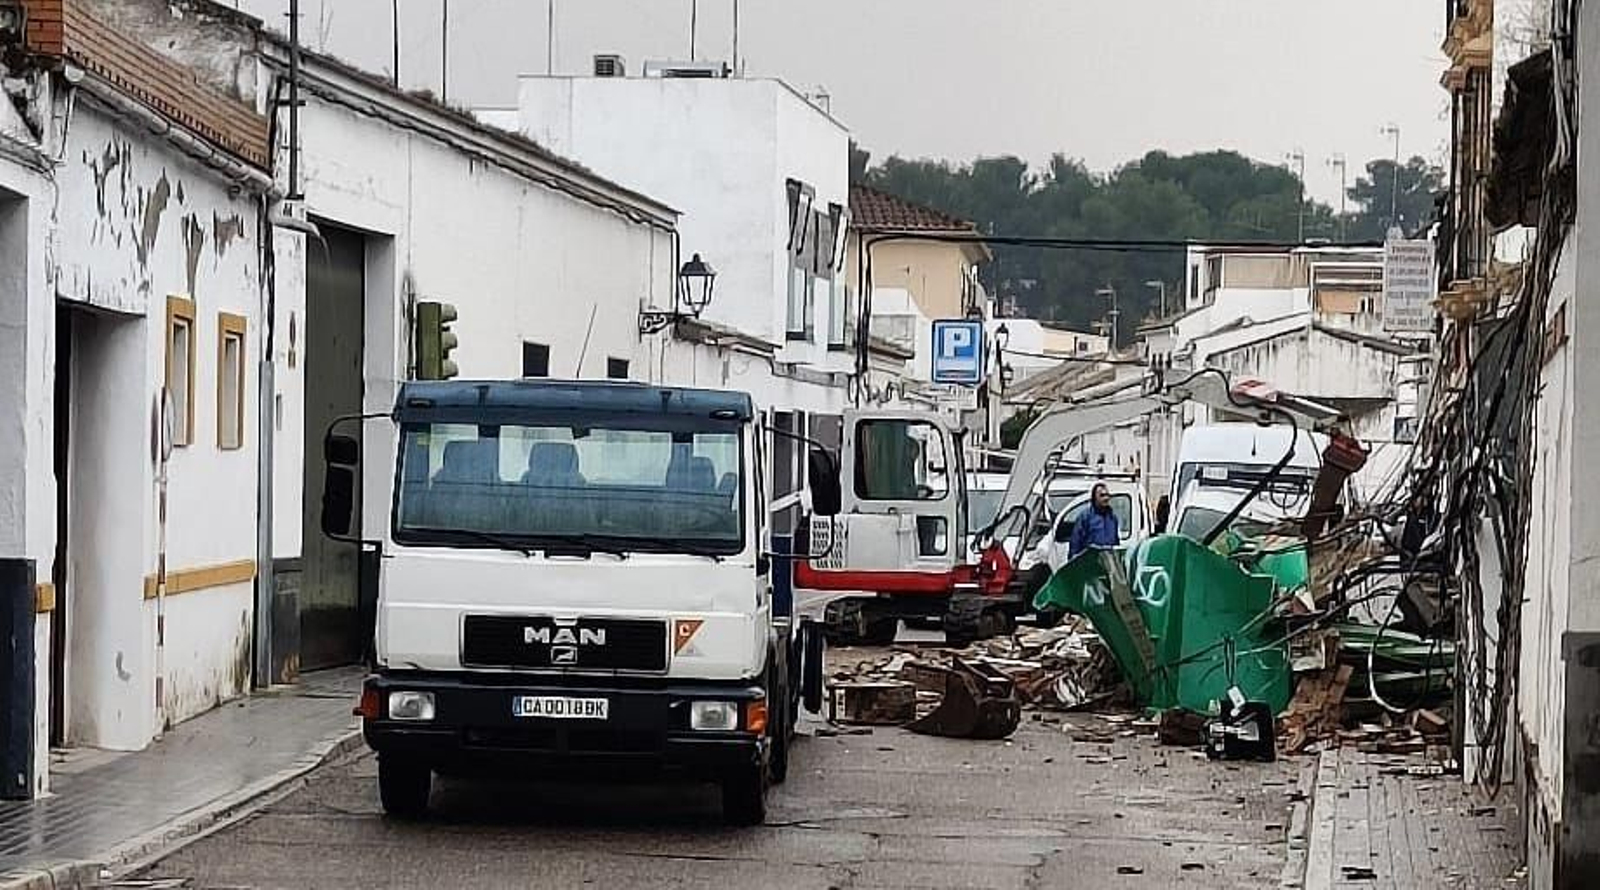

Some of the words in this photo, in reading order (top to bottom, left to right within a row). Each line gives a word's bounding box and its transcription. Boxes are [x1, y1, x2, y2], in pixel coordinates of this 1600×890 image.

[944, 327, 971, 357] P
[524, 627, 606, 645] MAN
[679, 624, 690, 637] C
